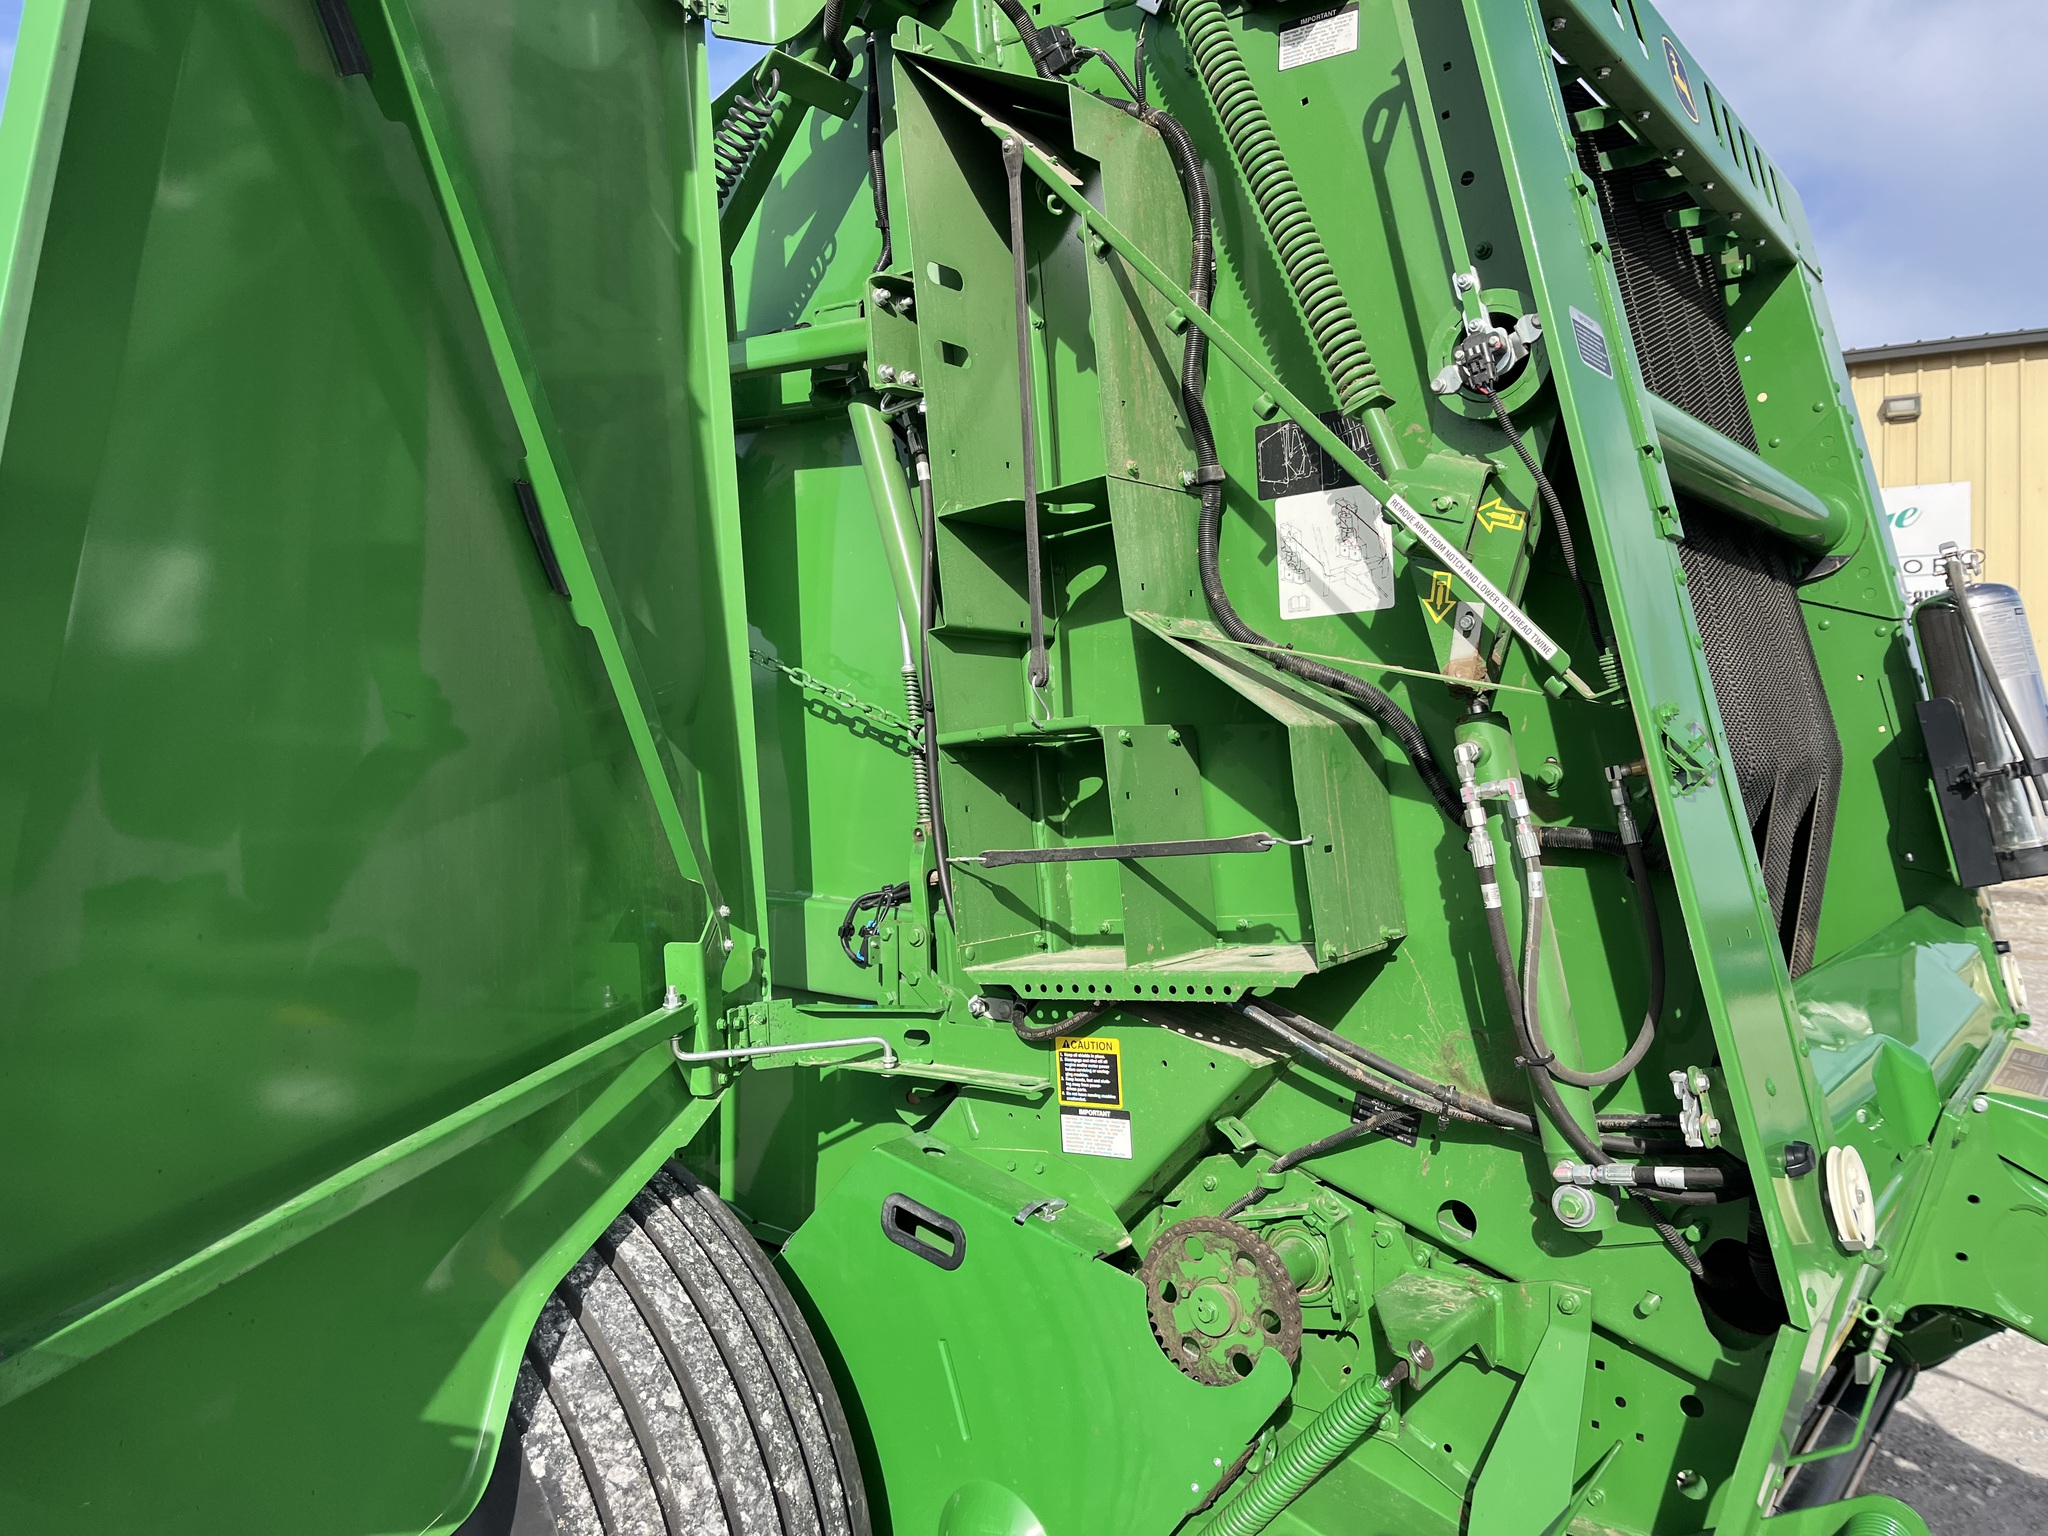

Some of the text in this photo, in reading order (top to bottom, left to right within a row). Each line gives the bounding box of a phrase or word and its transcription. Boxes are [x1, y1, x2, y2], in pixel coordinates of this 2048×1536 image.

[1300, 9, 1337, 25] IMPORTANT
[1390, 498, 1553, 656] REMOVE ARM FROM NOTCH AND LOWER TO THREAD TWINE
[1070, 1040, 1113, 1051] CAUTION
[1078, 1108, 1111, 1117] IMPORTANT
